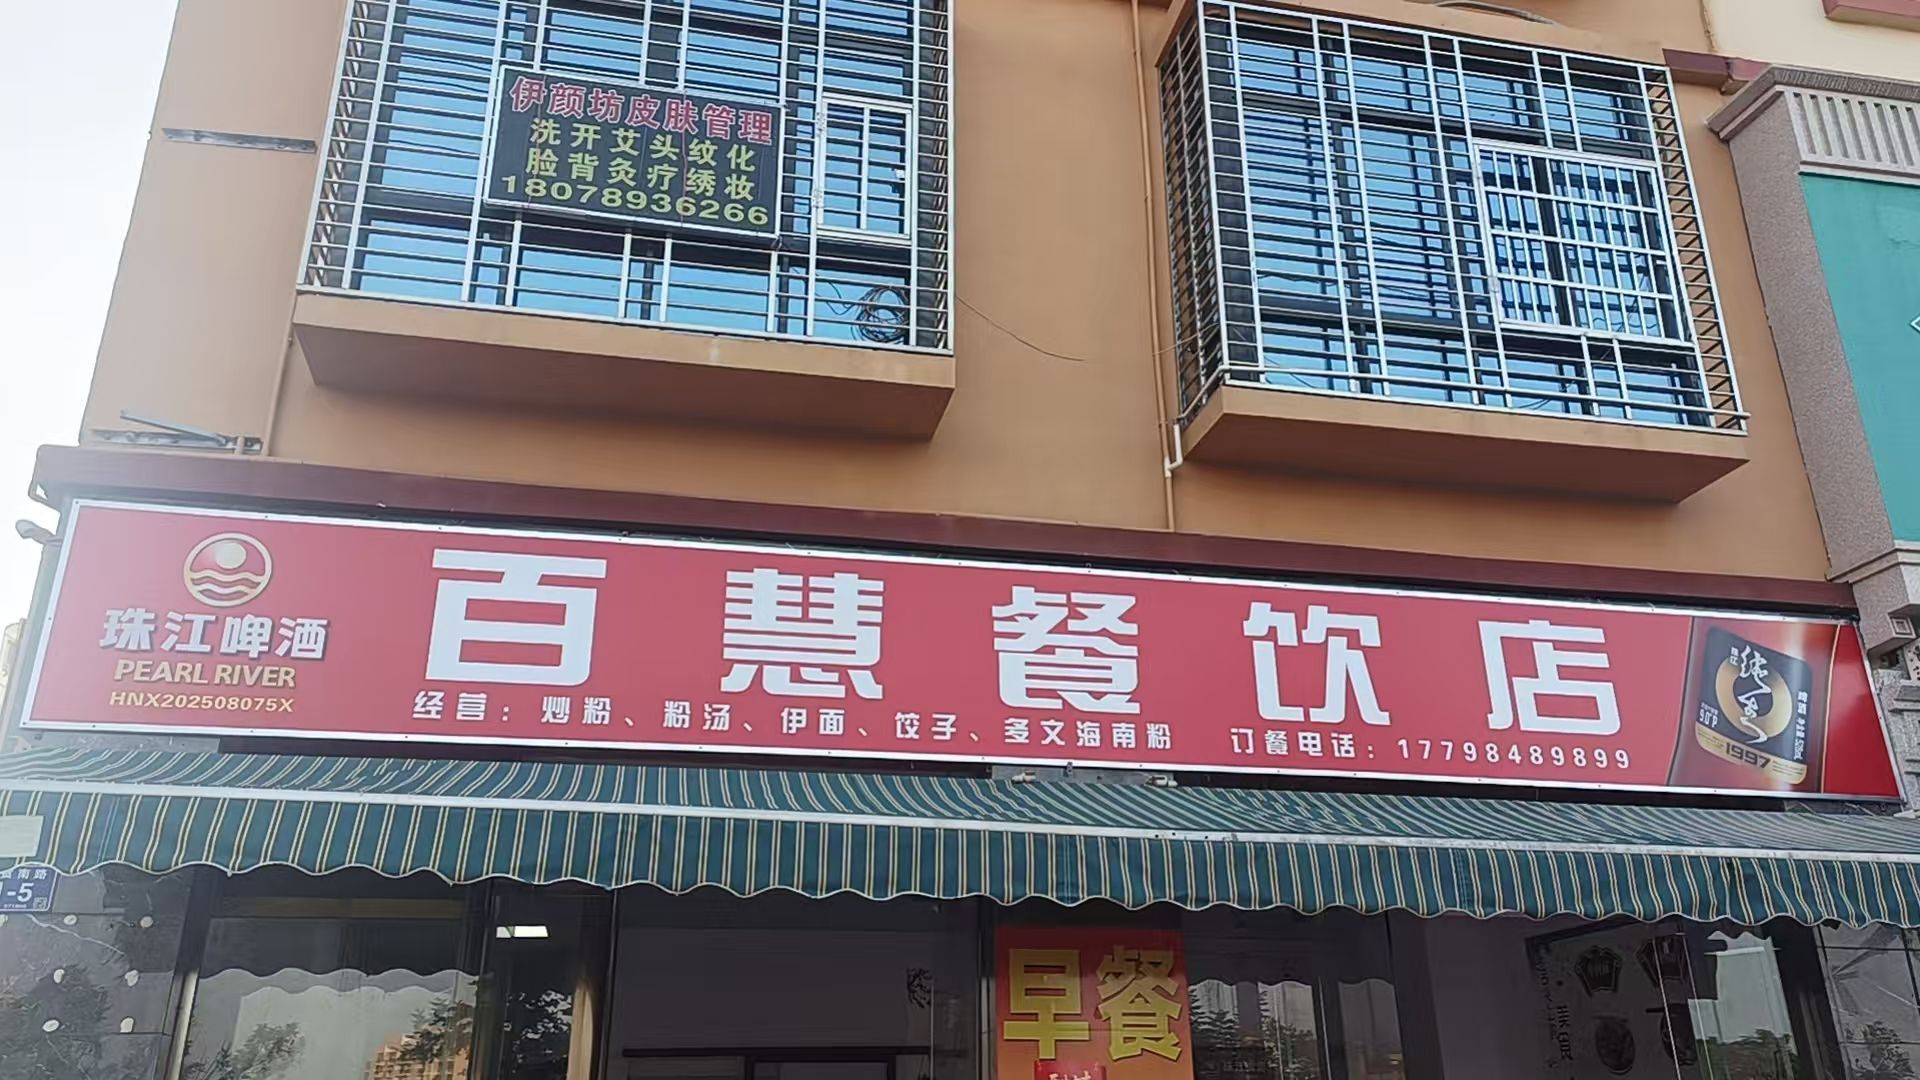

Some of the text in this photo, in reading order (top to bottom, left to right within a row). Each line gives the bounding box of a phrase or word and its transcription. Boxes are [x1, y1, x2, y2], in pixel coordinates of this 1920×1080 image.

[510, 75, 773, 145] 伊颜坊皮肤管理
[502, 175, 769, 226] 18078936266
[100, 607, 328, 660] 珠江啤酒
[425, 548, 1621, 735] 百慧餐饮店
[114, 659, 296, 688] PEARL RIVER
[110, 691, 295, 713] HNX202508075X
[1726, 742, 1771, 769] 1997
[1003, 945, 1182, 1061] 早餐
